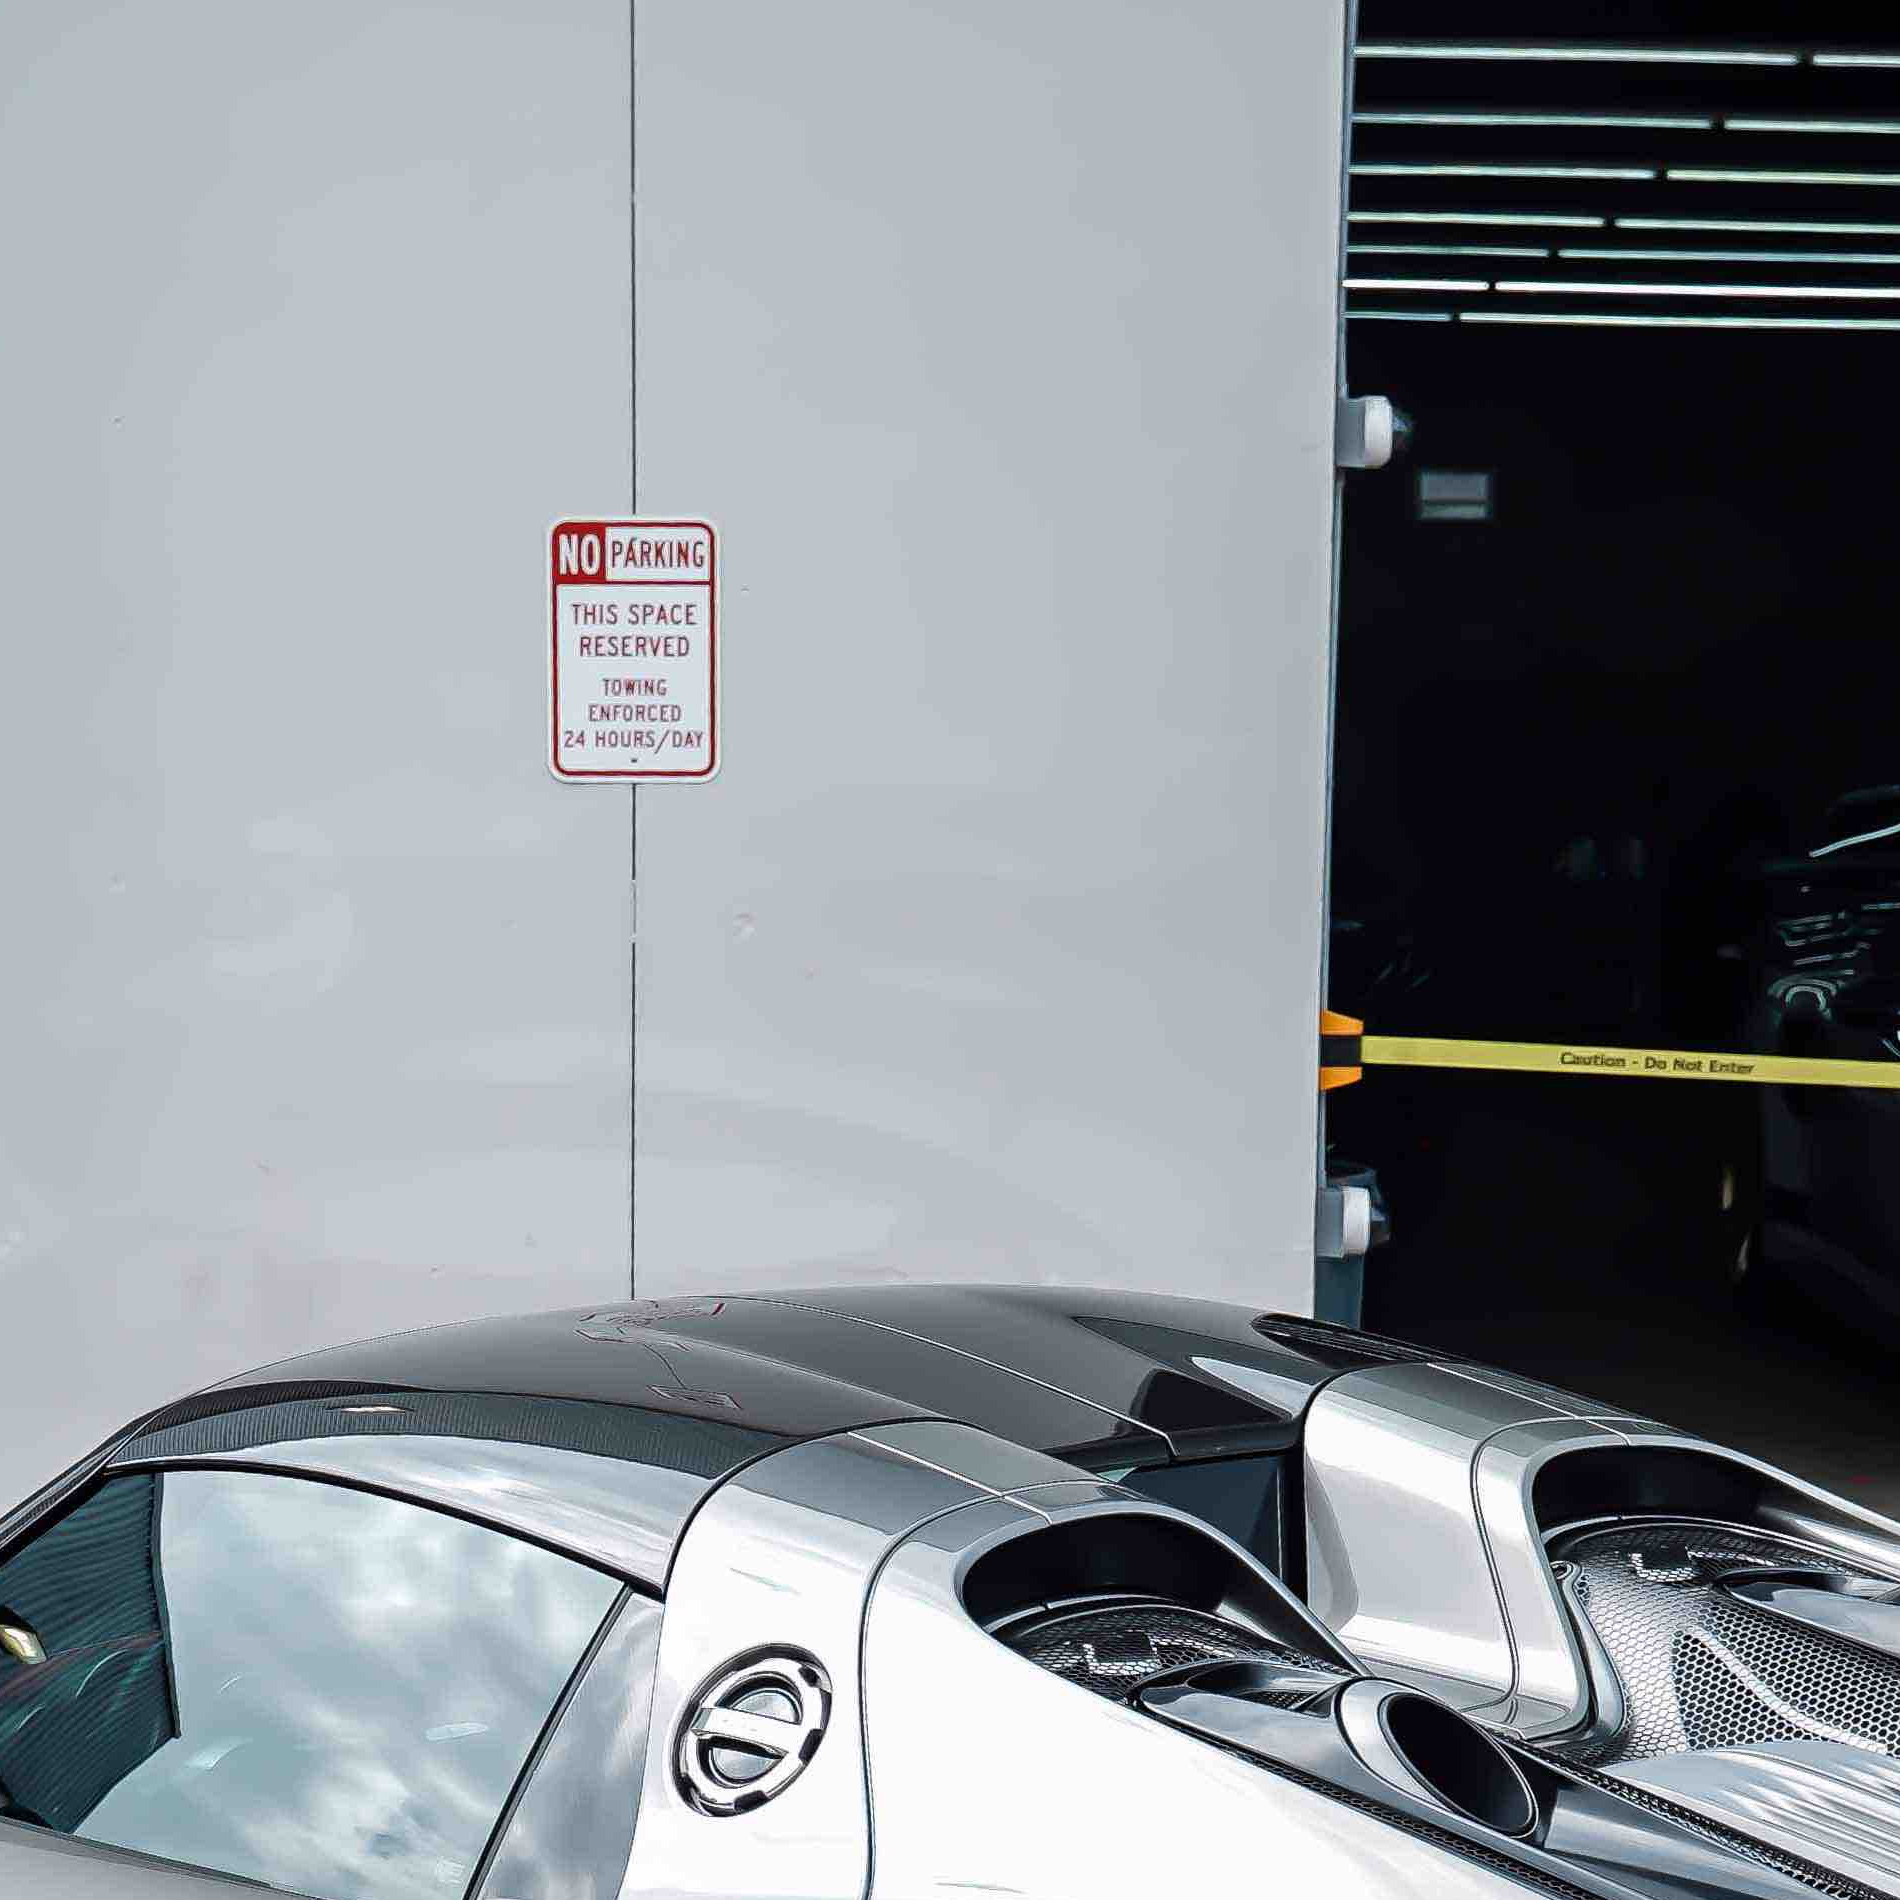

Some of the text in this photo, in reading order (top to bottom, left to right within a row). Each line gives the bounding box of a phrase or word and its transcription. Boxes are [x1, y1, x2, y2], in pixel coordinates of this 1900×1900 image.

[558, 533, 705, 576] NO PARKING
[572, 603, 698, 625] THIS SPACE
[579, 635, 691, 657] RESERVED
[602, 678, 669, 697] TOWING
[588, 703, 682, 723] ENFORCED
[563, 730, 704, 755] 24 HOURS/DAY
[1559, 1051, 1627, 1067] Caution
[1644, 1056, 1668, 1071] Do
[1672, 1057, 1704, 1072] Not
[1708, 1059, 1756, 1075] Enter
